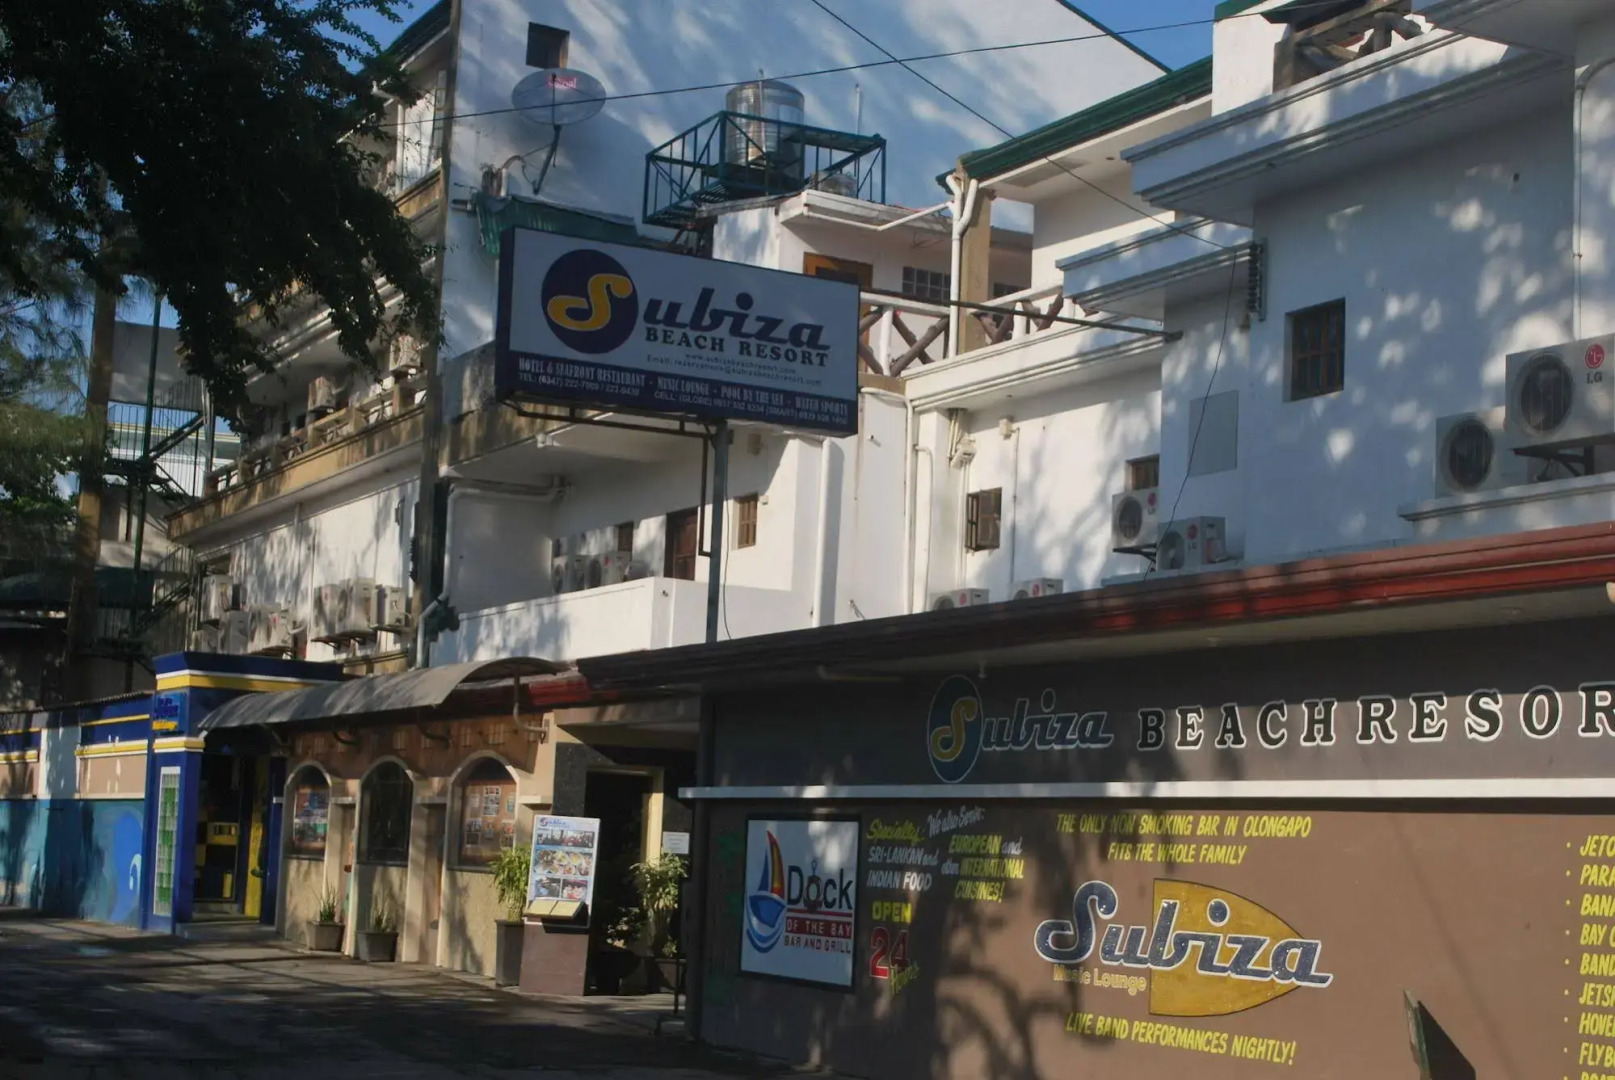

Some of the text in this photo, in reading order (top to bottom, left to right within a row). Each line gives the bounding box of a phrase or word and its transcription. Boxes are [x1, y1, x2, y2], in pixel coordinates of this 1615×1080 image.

[547, 273, 830, 352] Subiza
[644, 325, 829, 368] BEACH RESORT
[518, 357, 545, 374] HOTEL
[555, 361, 595, 381] SEAFRONT
[597, 367, 646, 388] RESTAURANT
[1586, 371, 1603, 384] LG
[657, 375, 711, 397] MUSIC LOUNGE
[720, 385, 742, 401] POOL
[743, 388, 754, 403] BY
[755, 389, 770, 405] THE
[930, 688, 1115, 762] Subiza
[1136, 699, 1338, 750] BEACH
[1056, 813, 1313, 840] THE ONLY NON SMOKING BAR IN OLONGAPO
[868, 845, 940, 866] SRI-LANKAN and
[949, 834, 1023, 856] EUROPEAN and
[1107, 841, 1249, 866] FITS THE WHOLE FAMILY
[959, 856, 1025, 880] INTERNATIONAL
[787, 864, 854, 911] Dock
[866, 870, 933, 892] INDIAN FOOD
[954, 879, 1006, 904] CUISINES!
[871, 900, 913, 924] OPEN
[786, 918, 853, 939] OF THE BAY
[1033, 879, 1334, 987] Subiza
[1579, 922, 1607, 946] BAY
[784, 934, 852, 955] BAR AND GRILL
[870, 926, 910, 979] 24
[1092, 967, 1148, 997] Lounge
[1578, 1011, 1615, 1038] HOVE
[1065, 1011, 1299, 1067] LIVE BAND PERFORMANCES NIGHTLY!
[1578, 1041, 1615, 1068] FLYB
